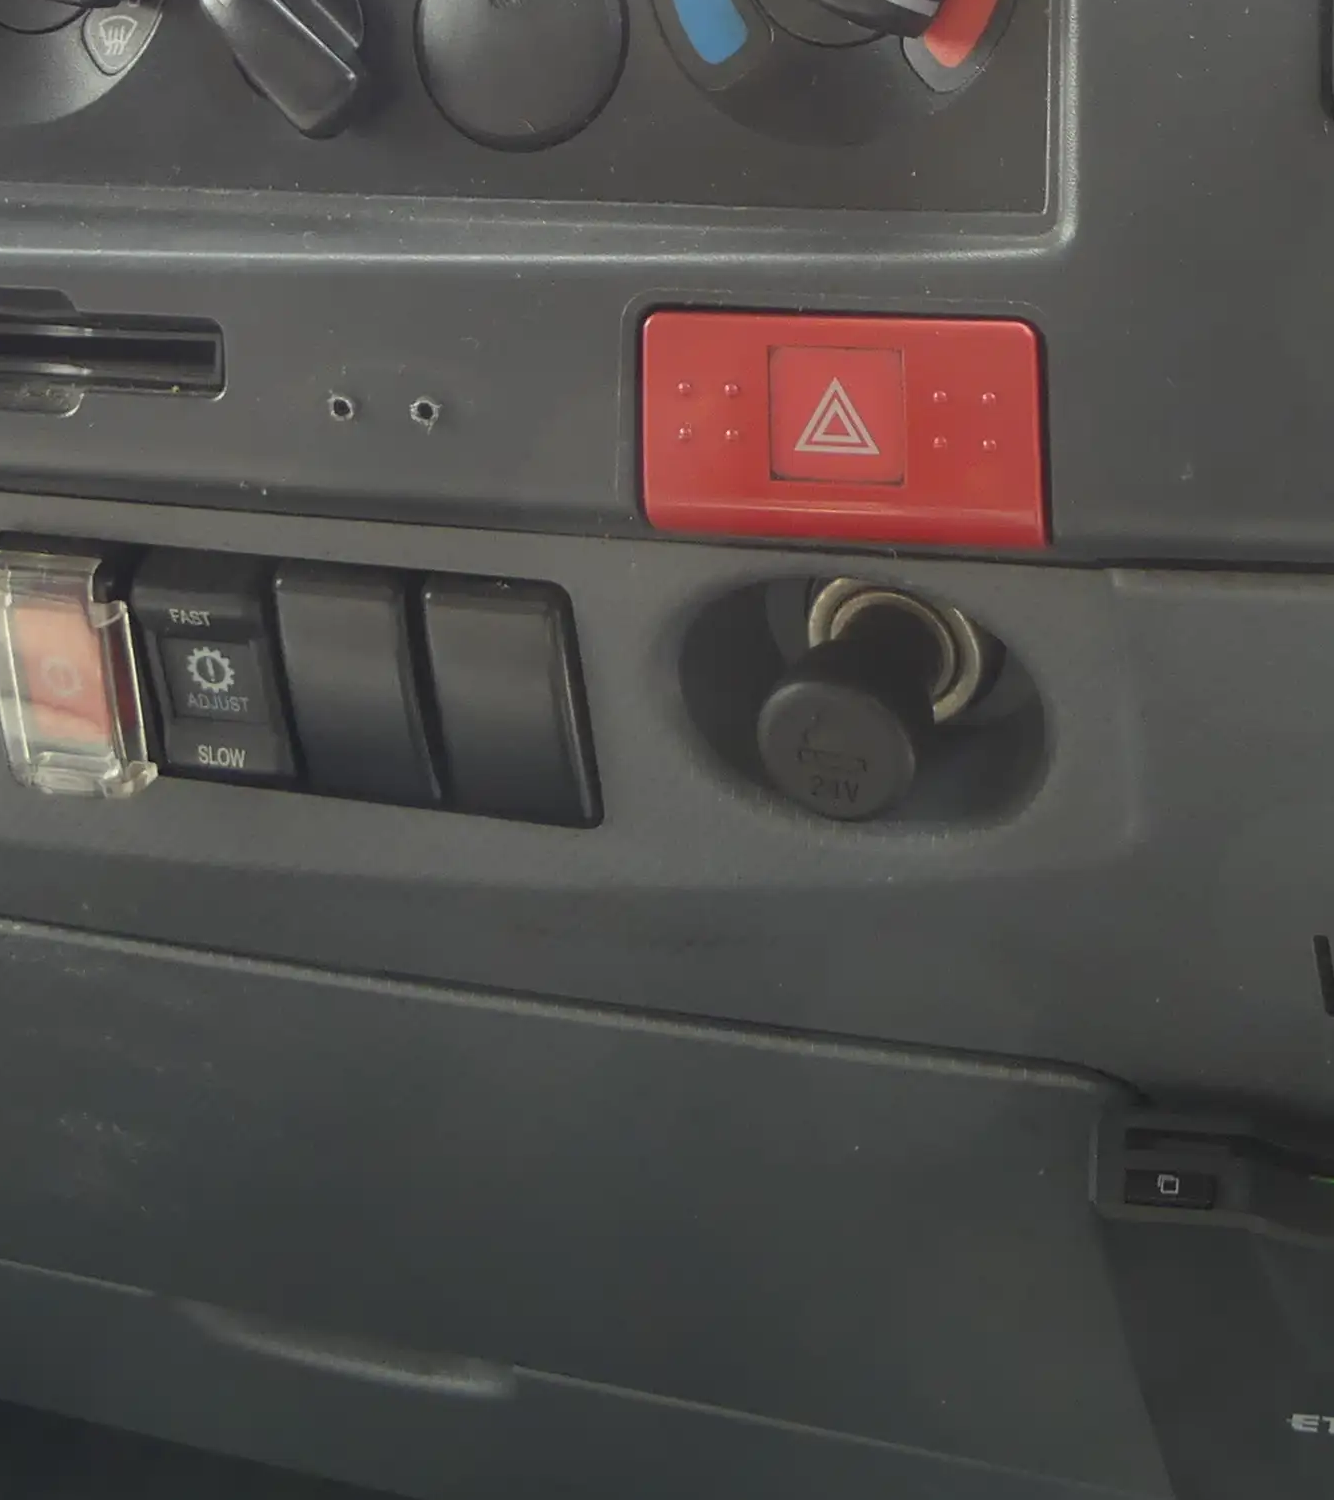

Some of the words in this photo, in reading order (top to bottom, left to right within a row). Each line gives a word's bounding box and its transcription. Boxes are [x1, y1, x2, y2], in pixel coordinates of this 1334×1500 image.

[168, 608, 211, 627] FAST
[186, 691, 250, 713] ADJUST
[197, 744, 247, 769] SLOW
